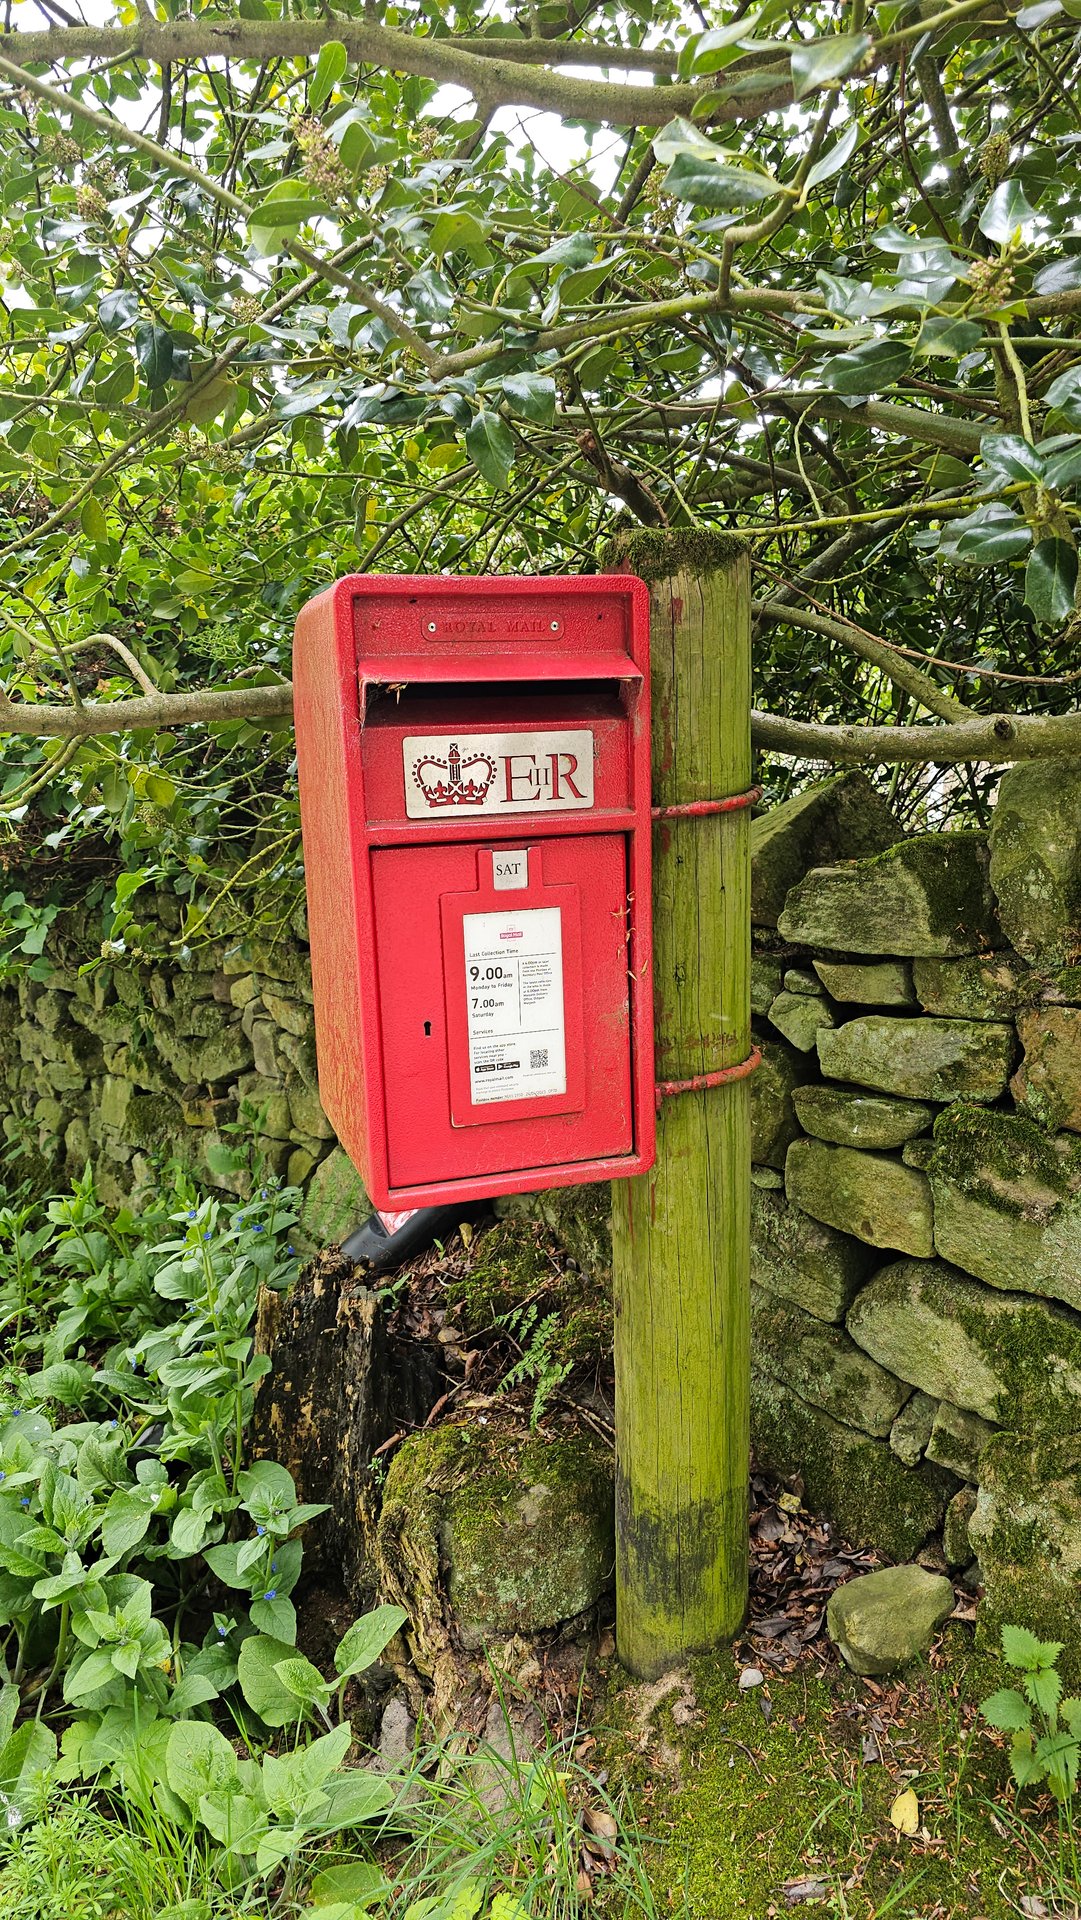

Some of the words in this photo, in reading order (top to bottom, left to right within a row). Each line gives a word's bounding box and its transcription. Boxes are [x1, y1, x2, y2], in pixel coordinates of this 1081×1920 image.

[443, 621, 496, 633] ROYAL
[506, 620, 545, 632] MAIL
[496, 863, 521, 876] SAT
[481, 949, 505, 957] Collection
[469, 966, 513, 981] 9.00am
[471, 998, 504, 1009] 7.00am
[474, 1075, 514, 1084] www.royalmail.com
